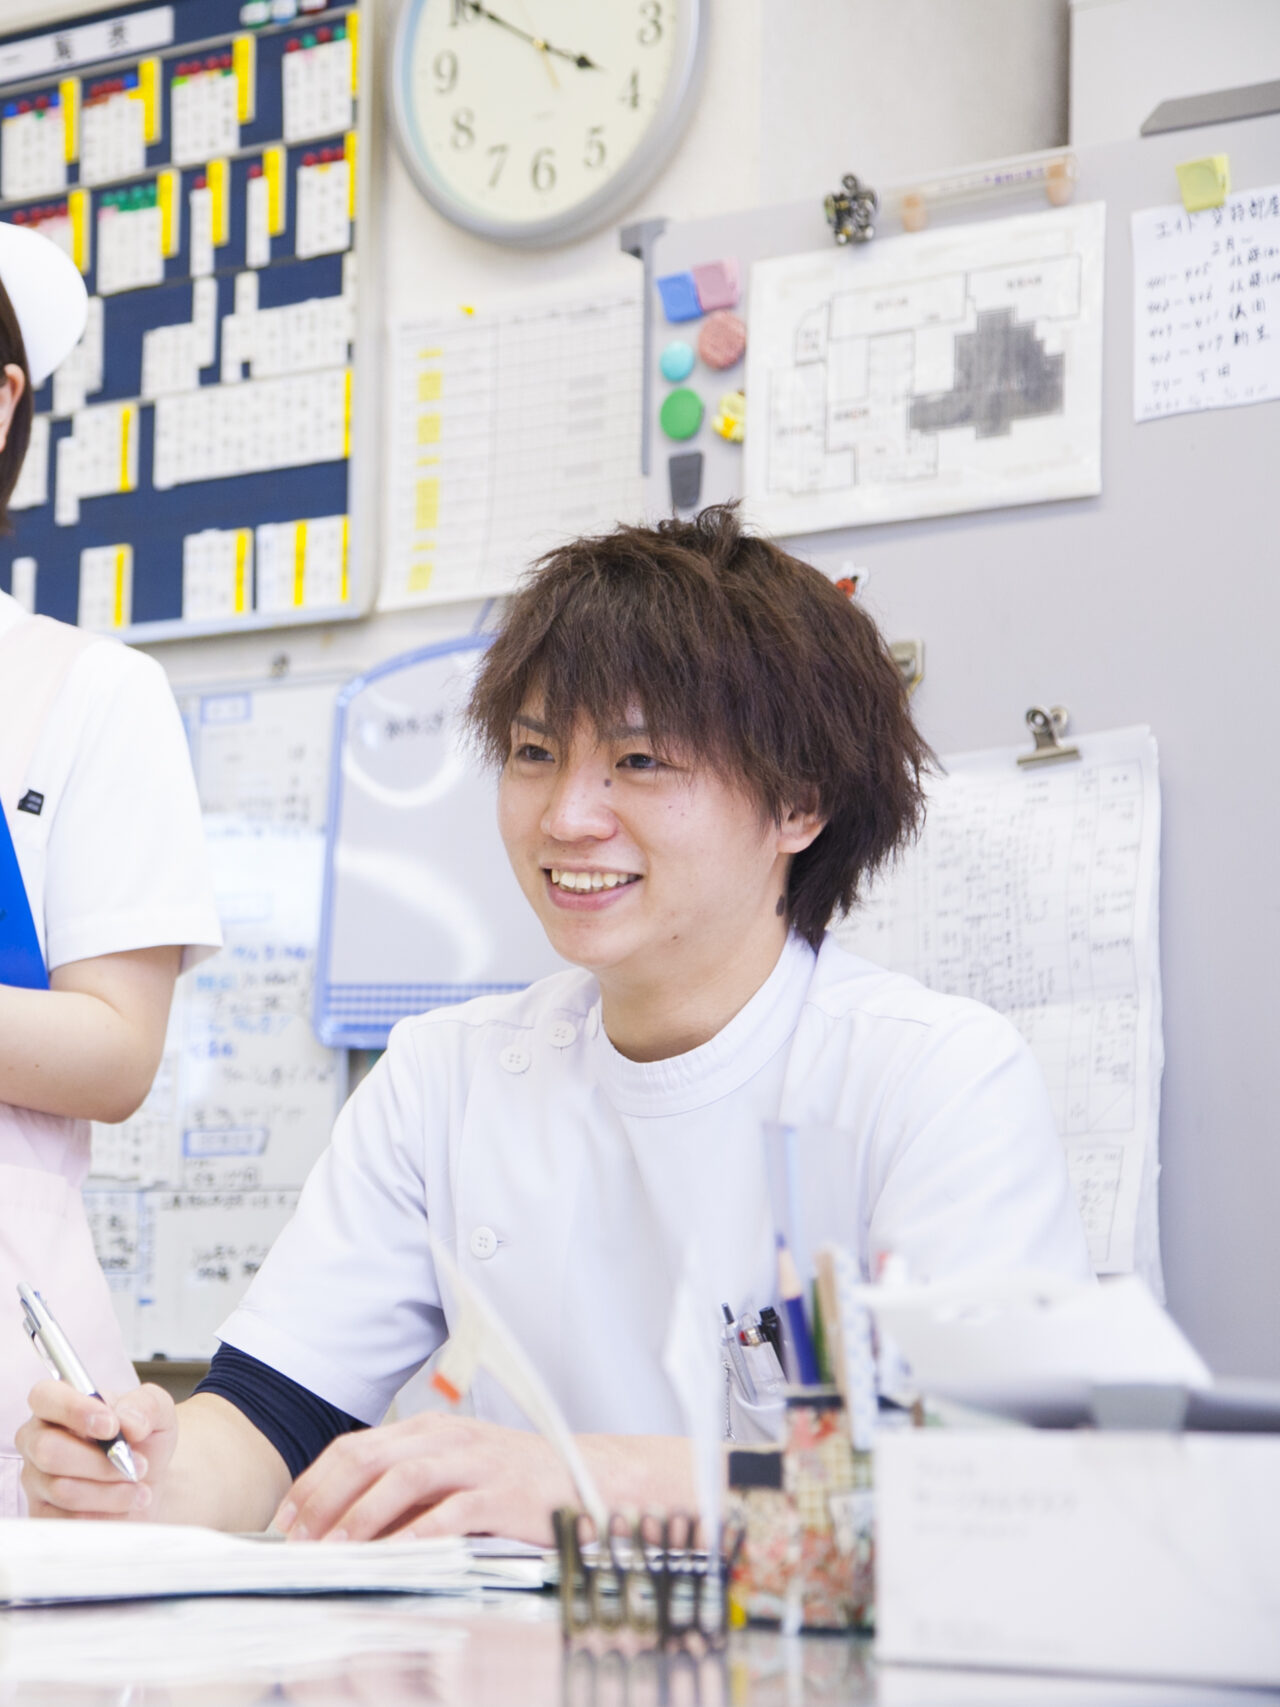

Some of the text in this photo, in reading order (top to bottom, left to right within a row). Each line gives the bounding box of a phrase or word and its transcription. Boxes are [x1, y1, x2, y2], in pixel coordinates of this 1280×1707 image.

[638, 1, 663, 45] 3
[433, 50, 459, 94] 9
[617, 68, 640, 109] 4
[450, 107, 476, 151] 8
[583, 124, 607, 169] 5
[486, 144, 510, 189] 7
[531, 147, 557, 192] 6
